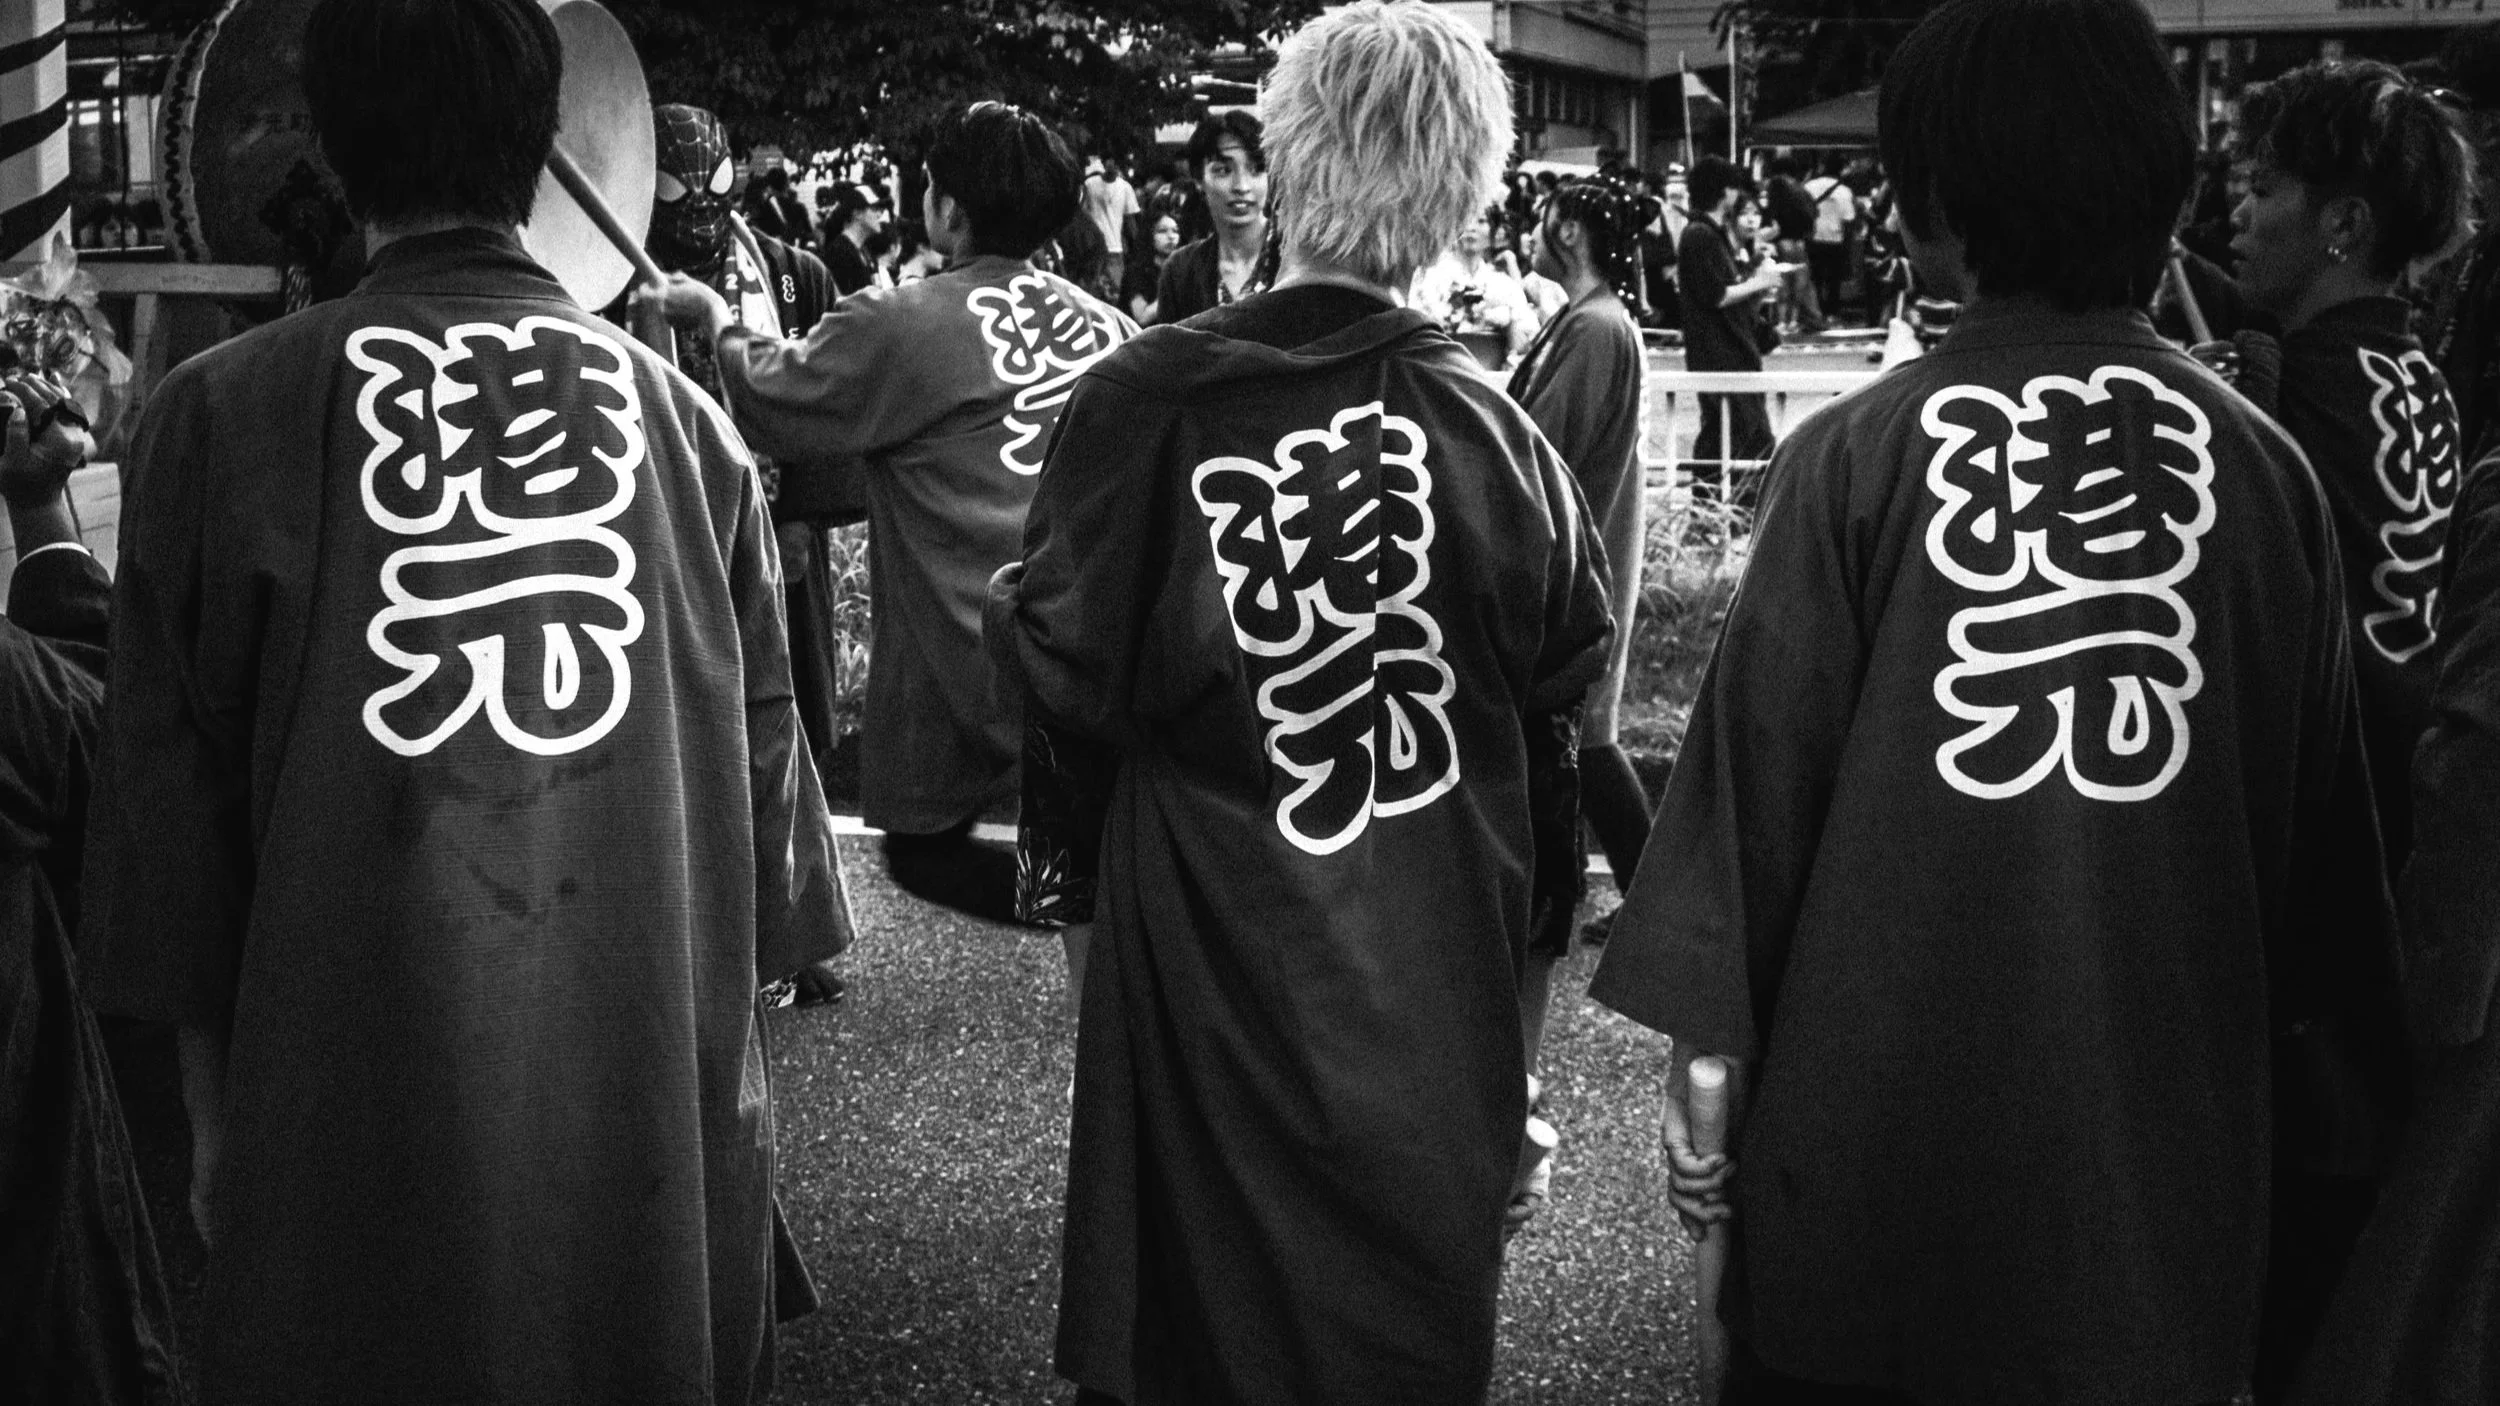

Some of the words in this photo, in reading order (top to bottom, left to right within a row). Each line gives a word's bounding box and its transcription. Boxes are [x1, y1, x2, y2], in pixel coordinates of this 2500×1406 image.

[345, 316, 646, 757] 港元
[1191, 400, 1461, 856] 港元
[1920, 365, 2217, 803] 港元
